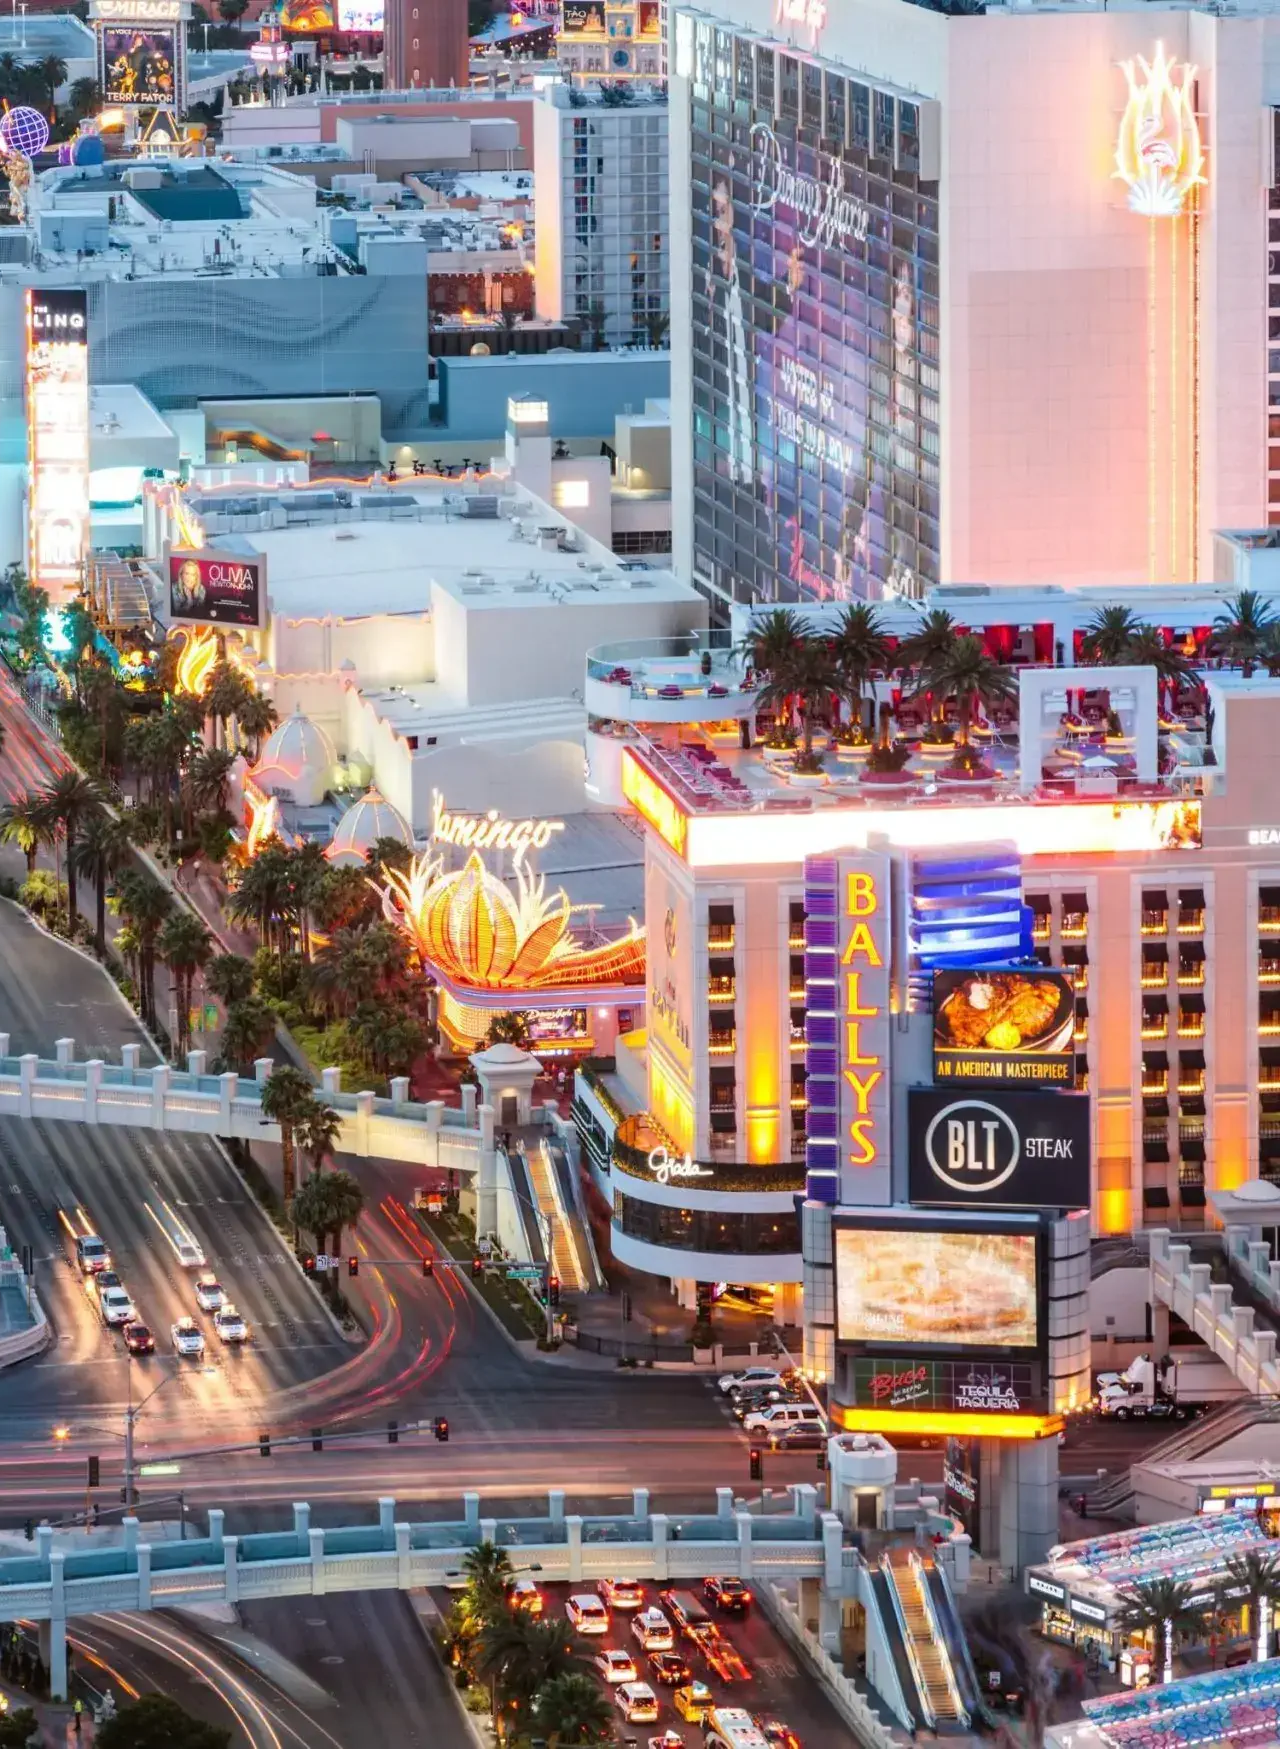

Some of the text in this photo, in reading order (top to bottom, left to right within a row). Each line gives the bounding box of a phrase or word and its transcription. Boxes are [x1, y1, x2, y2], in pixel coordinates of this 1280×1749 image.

[117, 1, 180, 16] MIRAGE
[565, 10, 586, 18] TAO
[106, 92, 173, 104] TERRY FATOR
[33, 313, 84, 328] LINQ
[209, 564, 253, 584] OLIVIA
[1248, 830, 1280, 845] BEA
[841, 872, 882, 1165] BALLYS
[938, 1061, 1068, 1079] AN AMERICAN MASTERPIECE
[947, 1119, 1000, 1171] BLT
[1025, 1137, 1073, 1159] STEAK
[648, 1146, 714, 1183] Giada
[959, 1385, 1015, 1397] TEQUILA
[956, 1396, 1019, 1410] TAQUERIA
